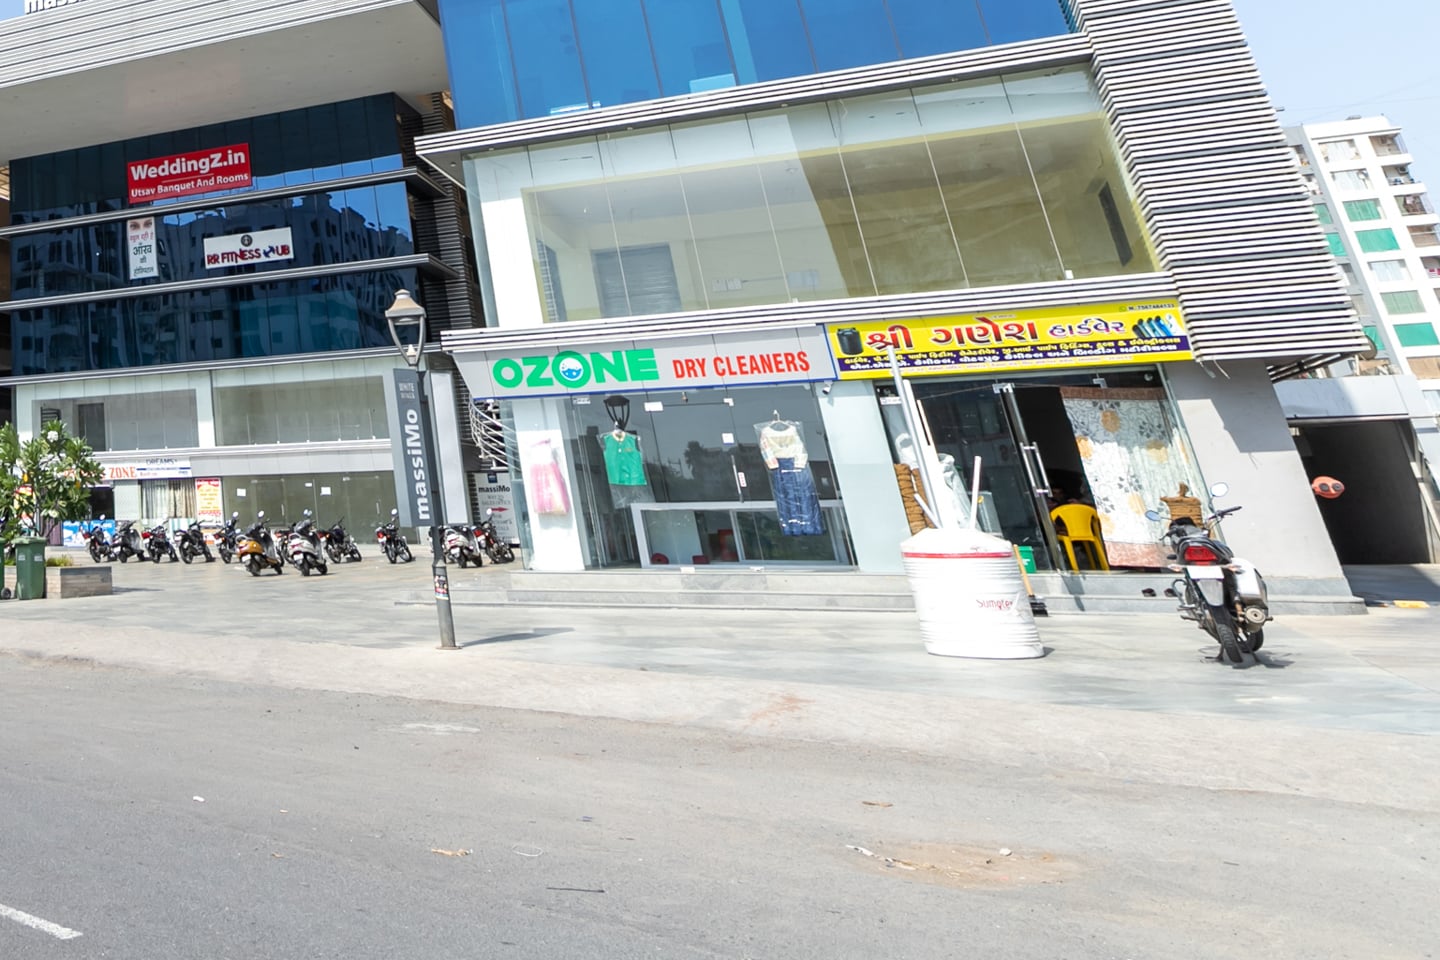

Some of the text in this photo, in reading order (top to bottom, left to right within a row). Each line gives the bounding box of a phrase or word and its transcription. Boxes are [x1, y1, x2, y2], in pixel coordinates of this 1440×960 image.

[131, 173, 249, 198] Utsav Banquet And Rooms
[207, 254, 220, 265] RR
[221, 248, 262, 264] FITNESS
[931, 316, 1039, 346] ગણેશ
[493, 348, 811, 389] OZONE DRY CLEANERS
[109, 467, 137, 479] ZONE
[405, 409, 430, 520] massiMo
[478, 485, 510, 493] massiMo
